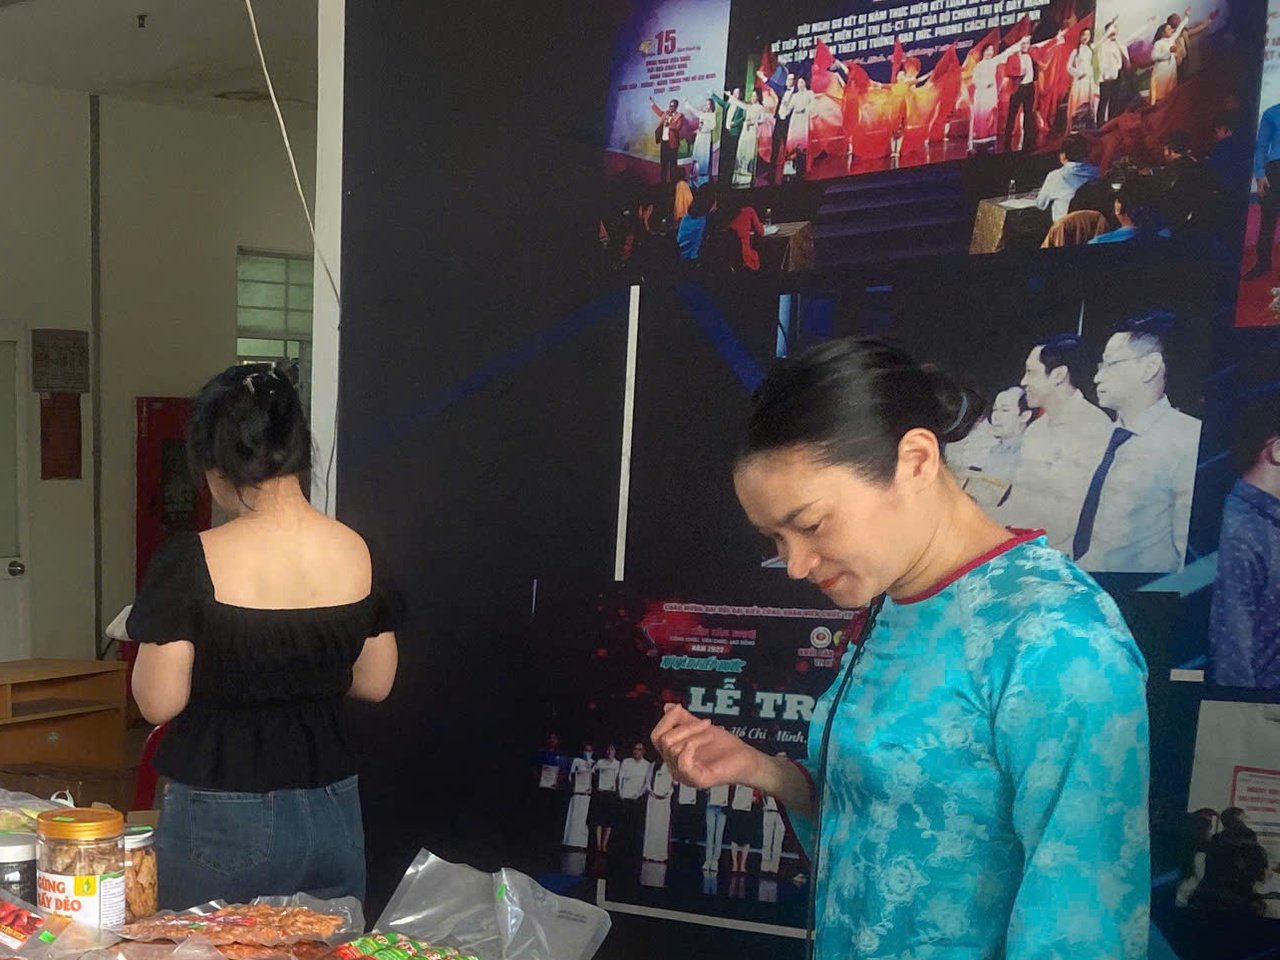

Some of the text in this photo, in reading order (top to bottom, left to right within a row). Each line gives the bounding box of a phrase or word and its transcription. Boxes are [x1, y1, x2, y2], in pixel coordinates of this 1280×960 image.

[655, 29, 677, 55] 15
[688, 677, 816, 722] LỄ TR
